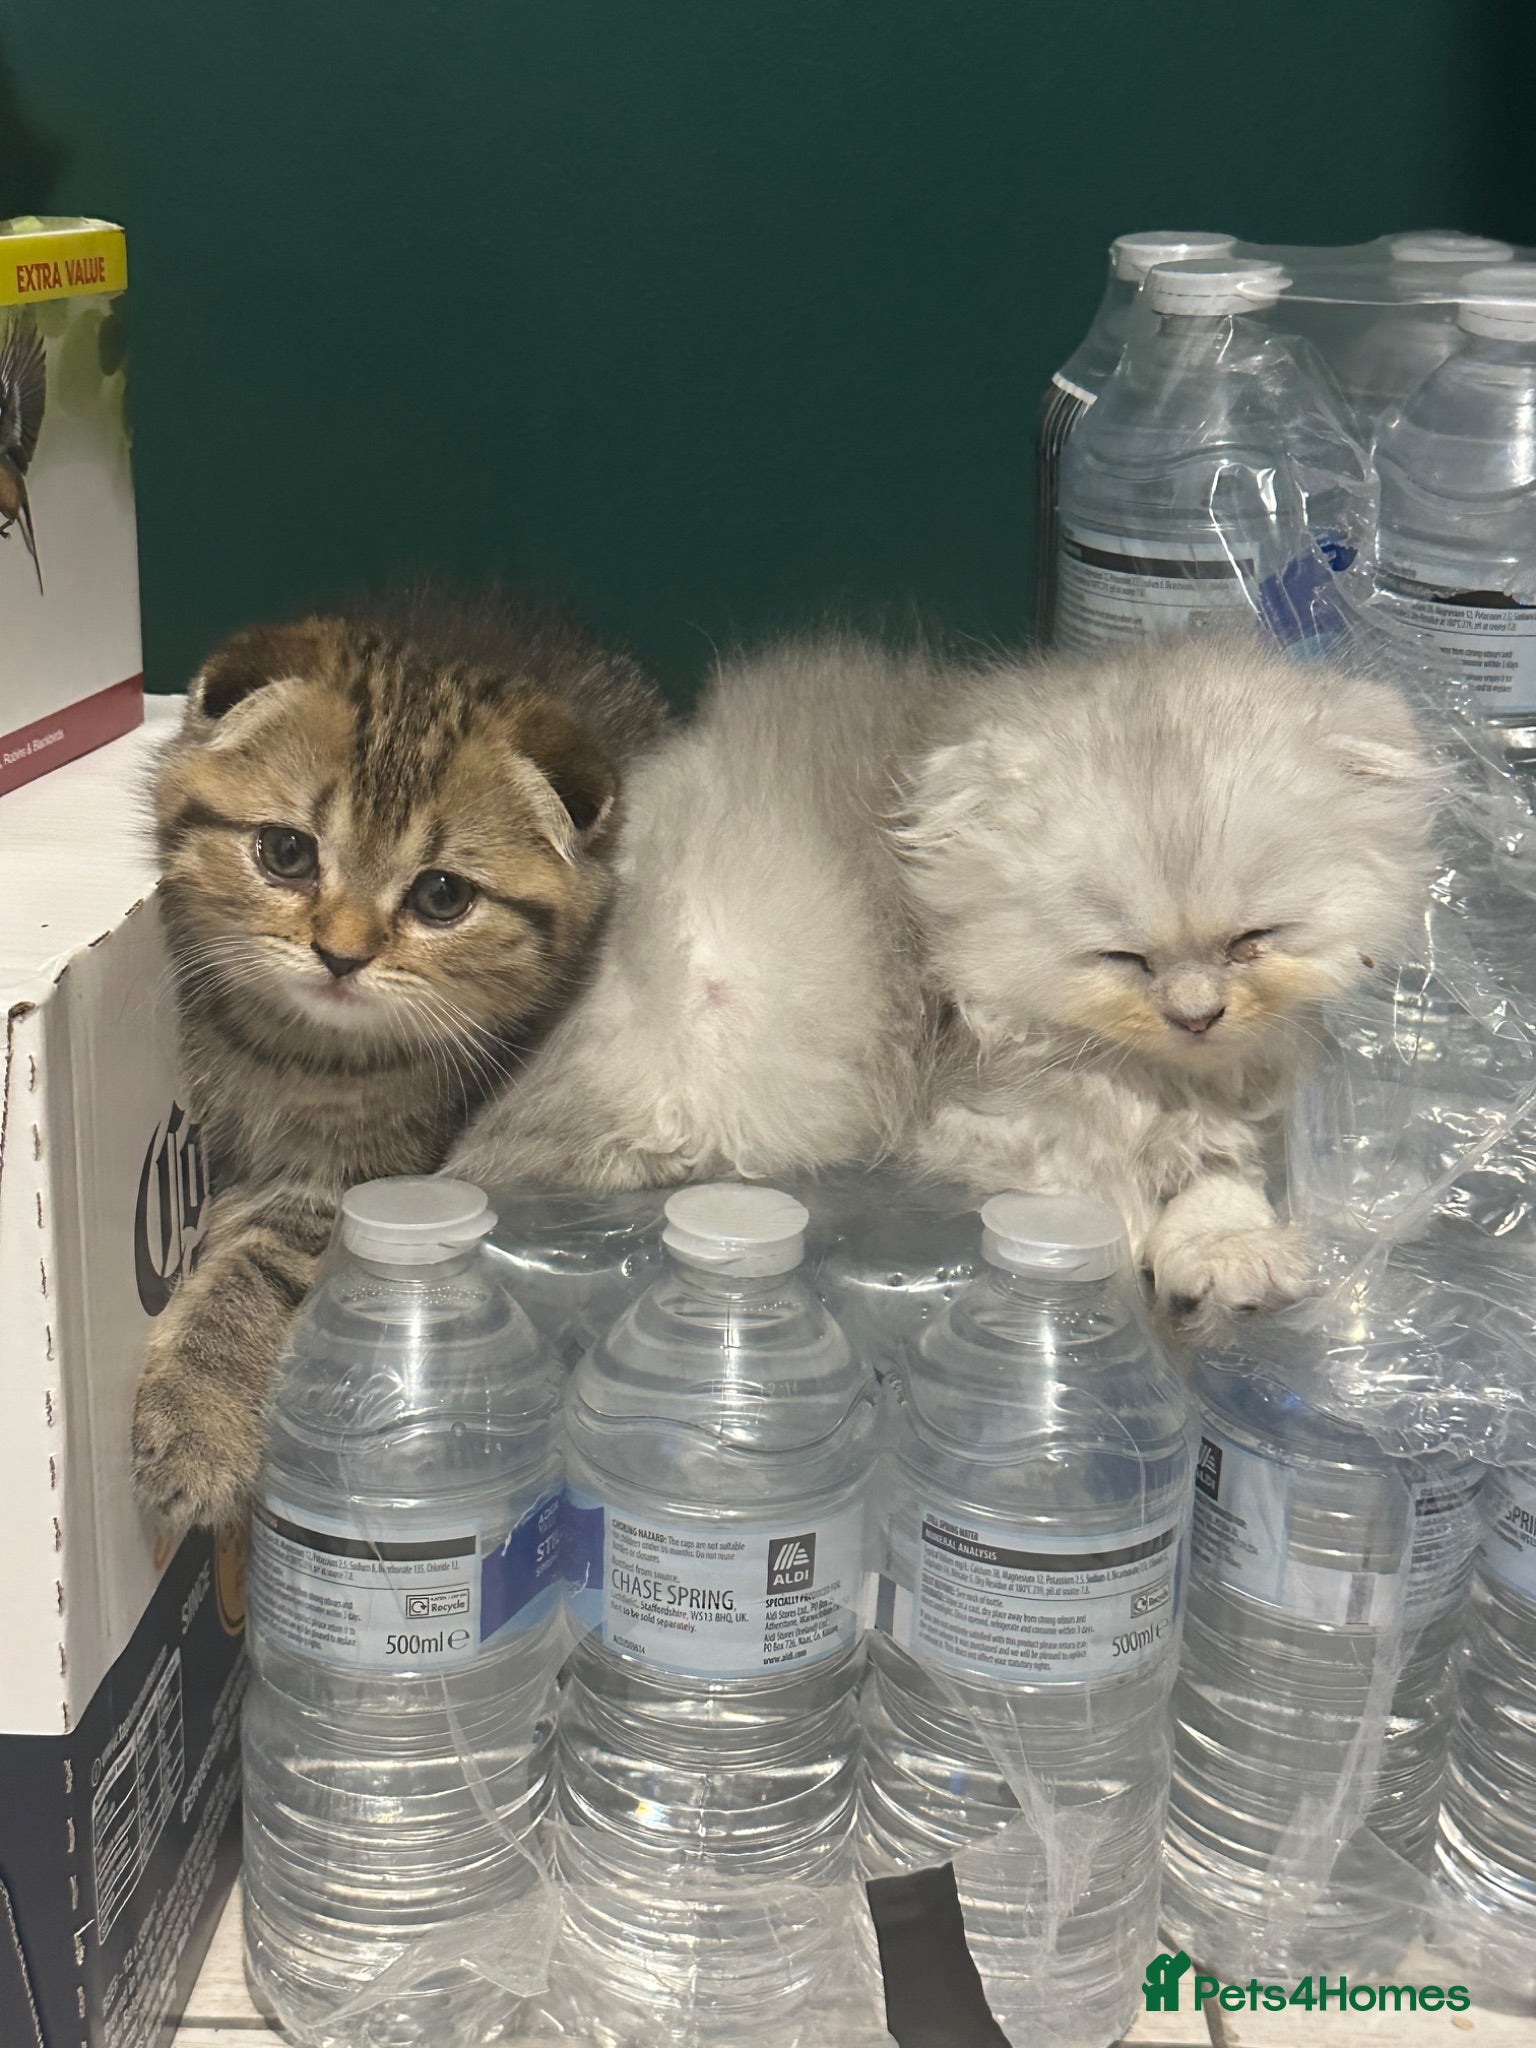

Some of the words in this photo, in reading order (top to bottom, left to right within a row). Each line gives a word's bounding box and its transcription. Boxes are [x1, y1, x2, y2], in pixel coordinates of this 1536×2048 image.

[16, 261, 63, 293] EXTRA
[65, 257, 106, 287] VALUE
[638, 1528, 667, 1544] HAZARD:
[668, 1535, 680, 1547] The
[707, 1542, 718, 1550] not
[719, 1541, 746, 1551] suitable
[957, 1526, 979, 1541] WATER
[957, 1543, 998, 1561] ANALYSIS
[635, 1564, 652, 1578] from
[773, 1570, 809, 1586] ALDI
[1001, 1568, 1036, 1582] Magnesium
[1046, 1575, 1075, 1585] Potassium
[611, 1569, 662, 1602] CHASE
[431, 1599, 465, 1613] Recycle
[765, 1594, 800, 1608] SPECIALLY
[690, 1611, 713, 1622] WS13
[778, 1608, 797, 1619] Stores
[1007, 1613, 1023, 1623] away
[640, 1613, 656, 1625] sold
[656, 1618, 697, 1633] separately.
[763, 1649, 808, 1665] www.aldi.com
